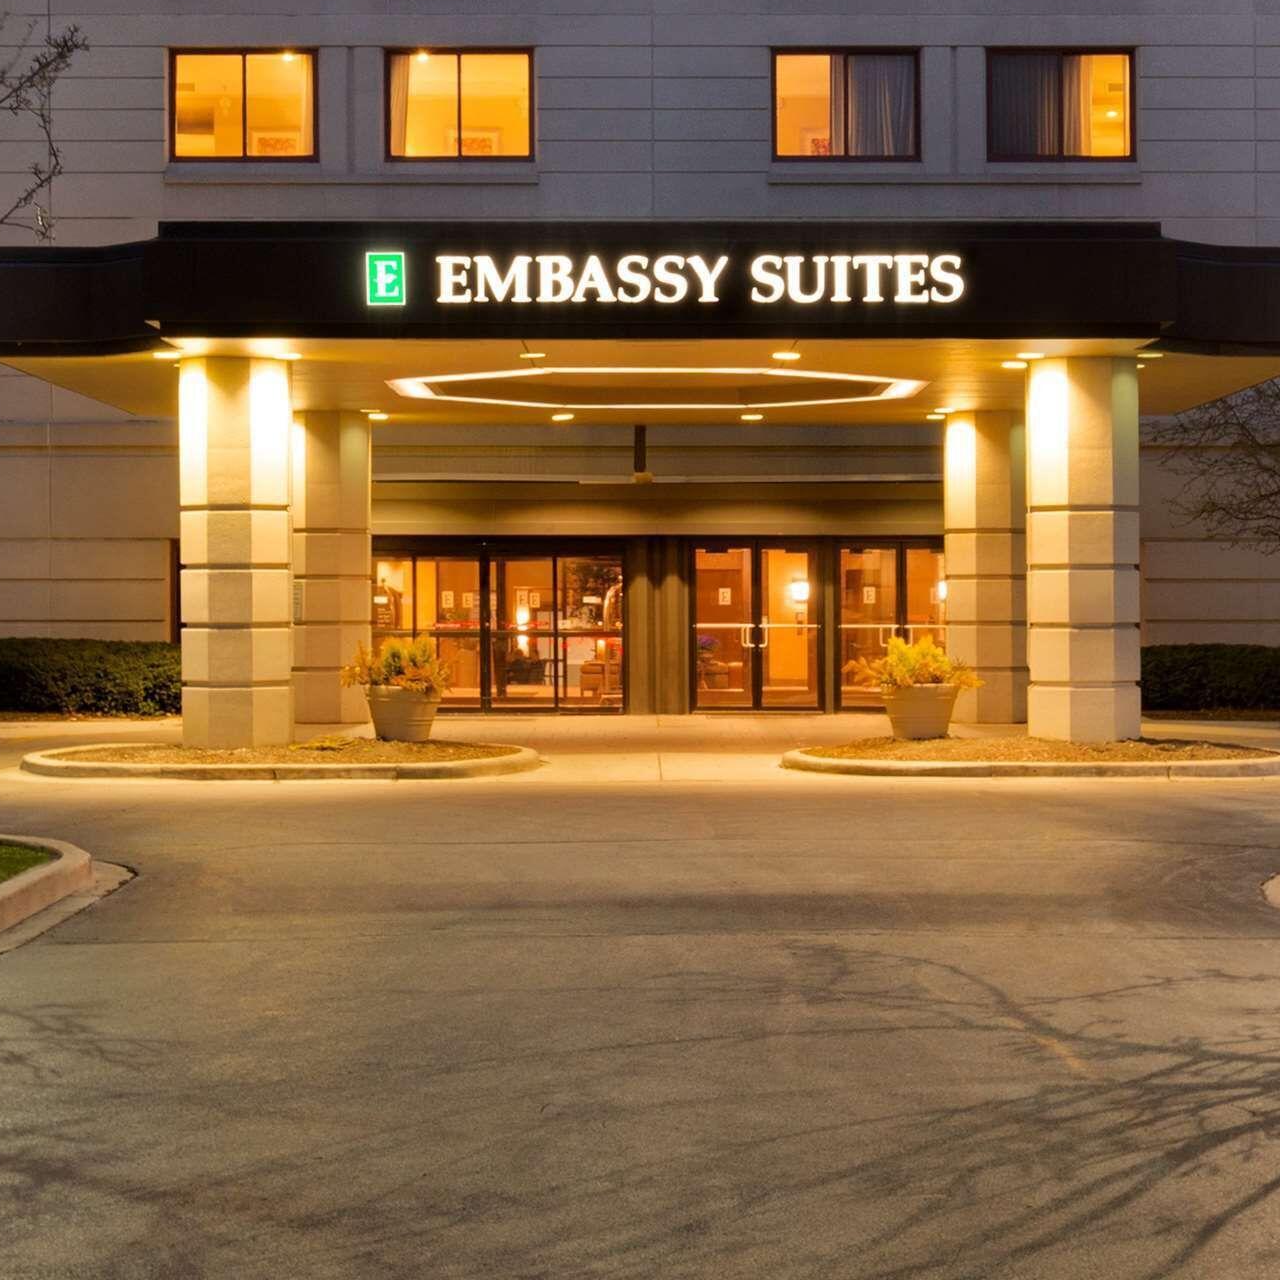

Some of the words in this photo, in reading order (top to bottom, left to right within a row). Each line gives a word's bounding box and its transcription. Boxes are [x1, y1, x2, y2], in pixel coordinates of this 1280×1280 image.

[374, 260, 400, 298] E
[435, 254, 729, 304] EMBASSY
[750, 253, 965, 304] SUITES
